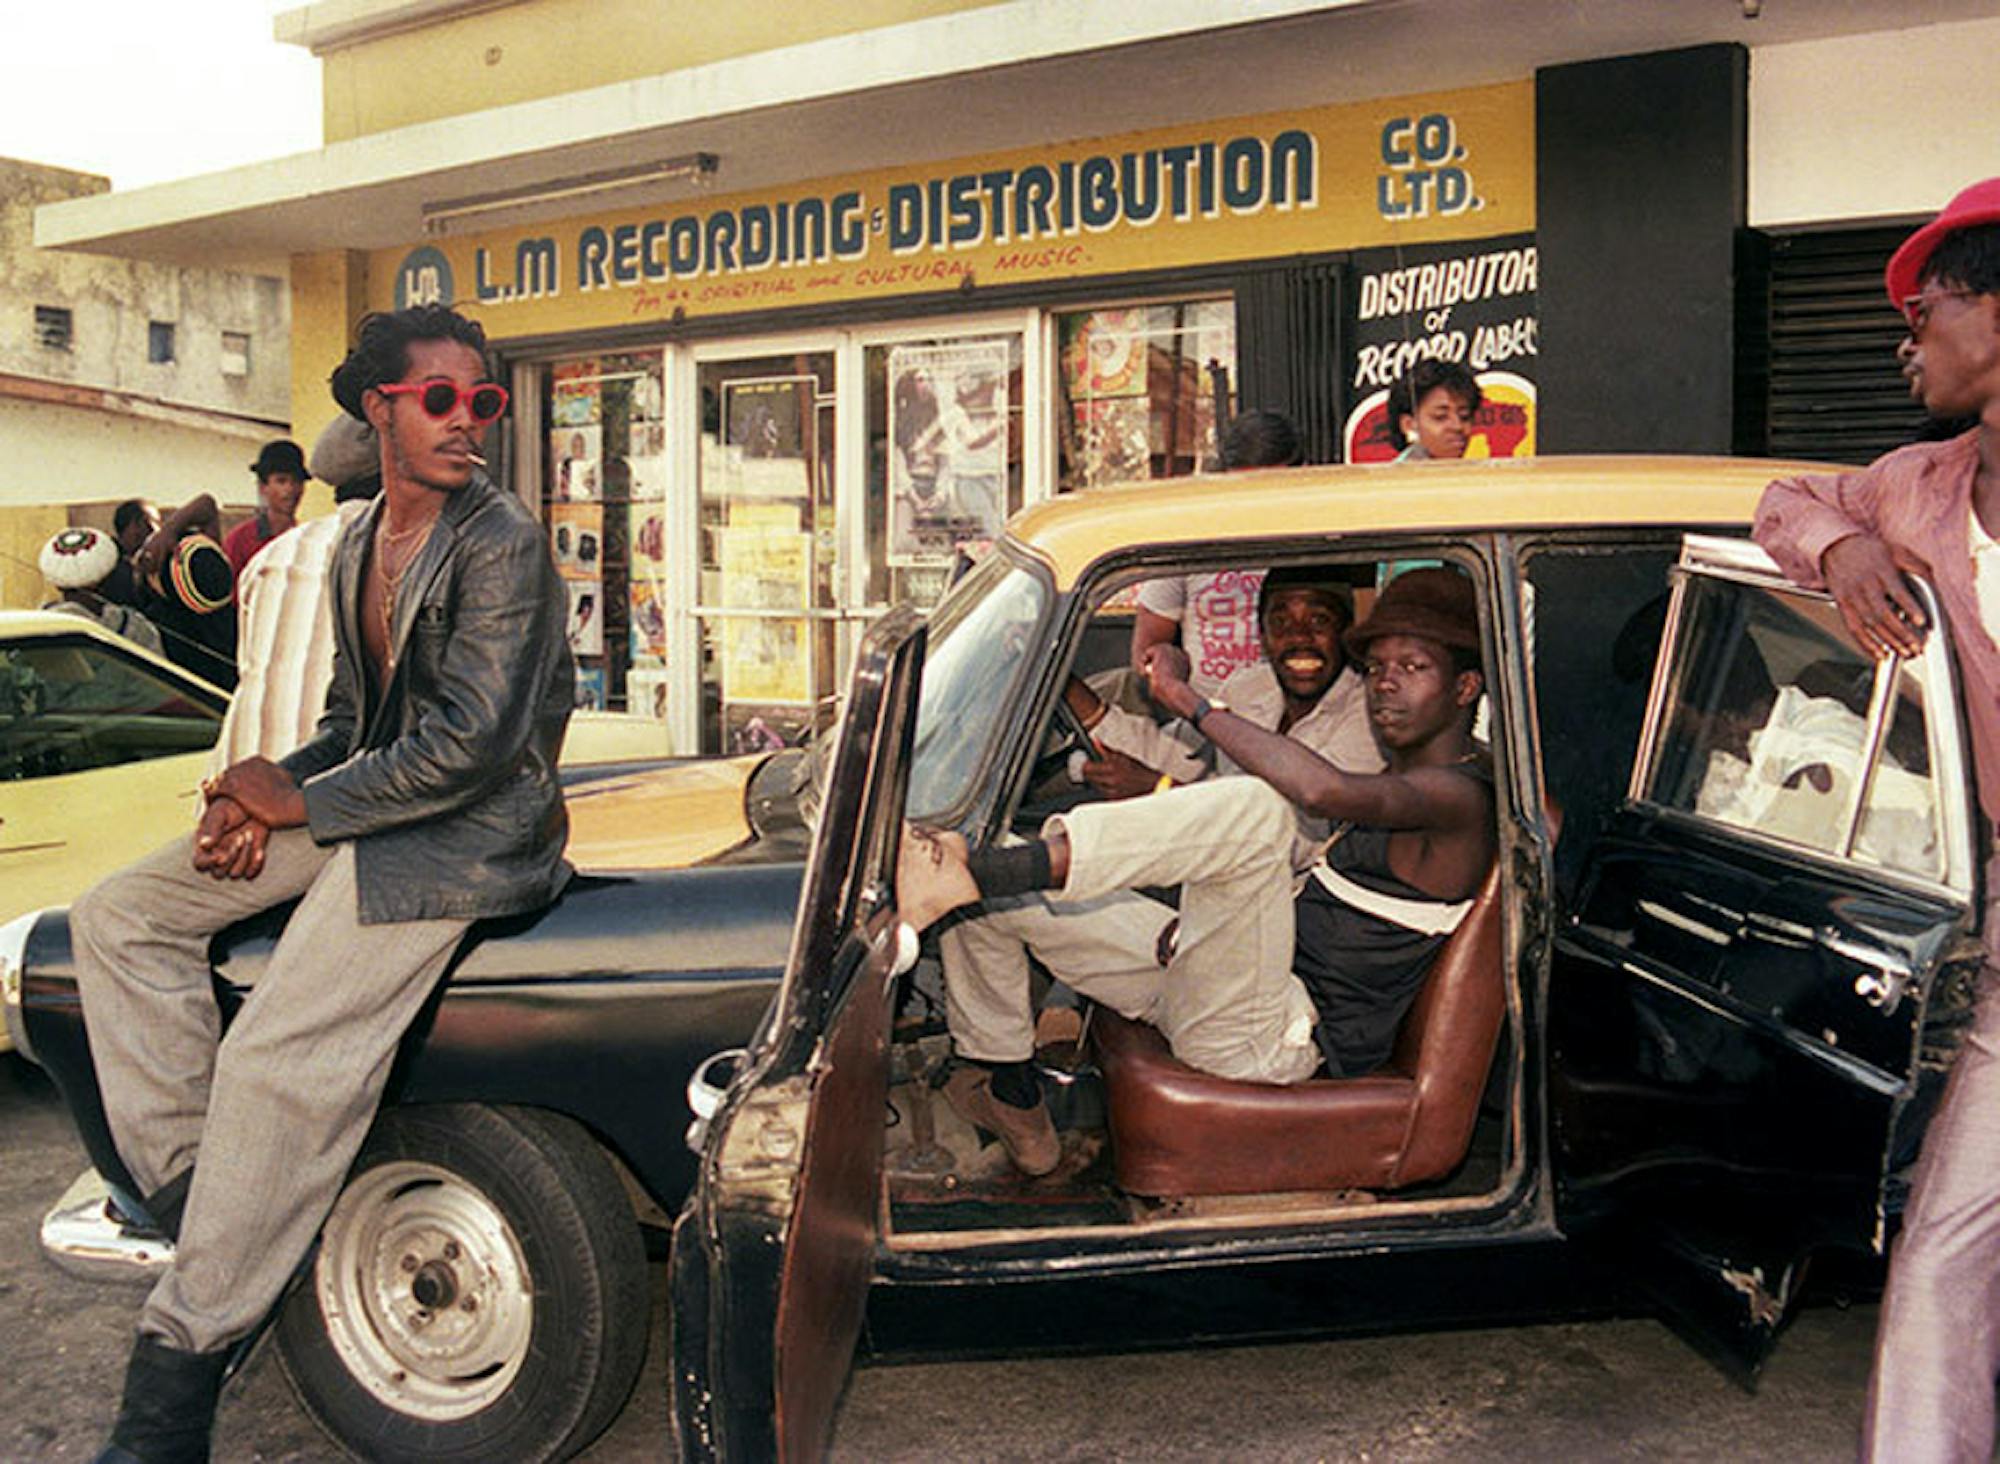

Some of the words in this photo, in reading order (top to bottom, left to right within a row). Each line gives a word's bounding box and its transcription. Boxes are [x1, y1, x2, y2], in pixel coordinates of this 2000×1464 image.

[1380, 113, 1468, 169] CO.
[578, 190, 869, 293] RECORDING
[889, 129, 1320, 256] DISTRIBUTION
[1378, 166, 1485, 221] LTD.
[855, 260, 974, 287] CULTURAL
[1354, 330, 1468, 388] RECORD
